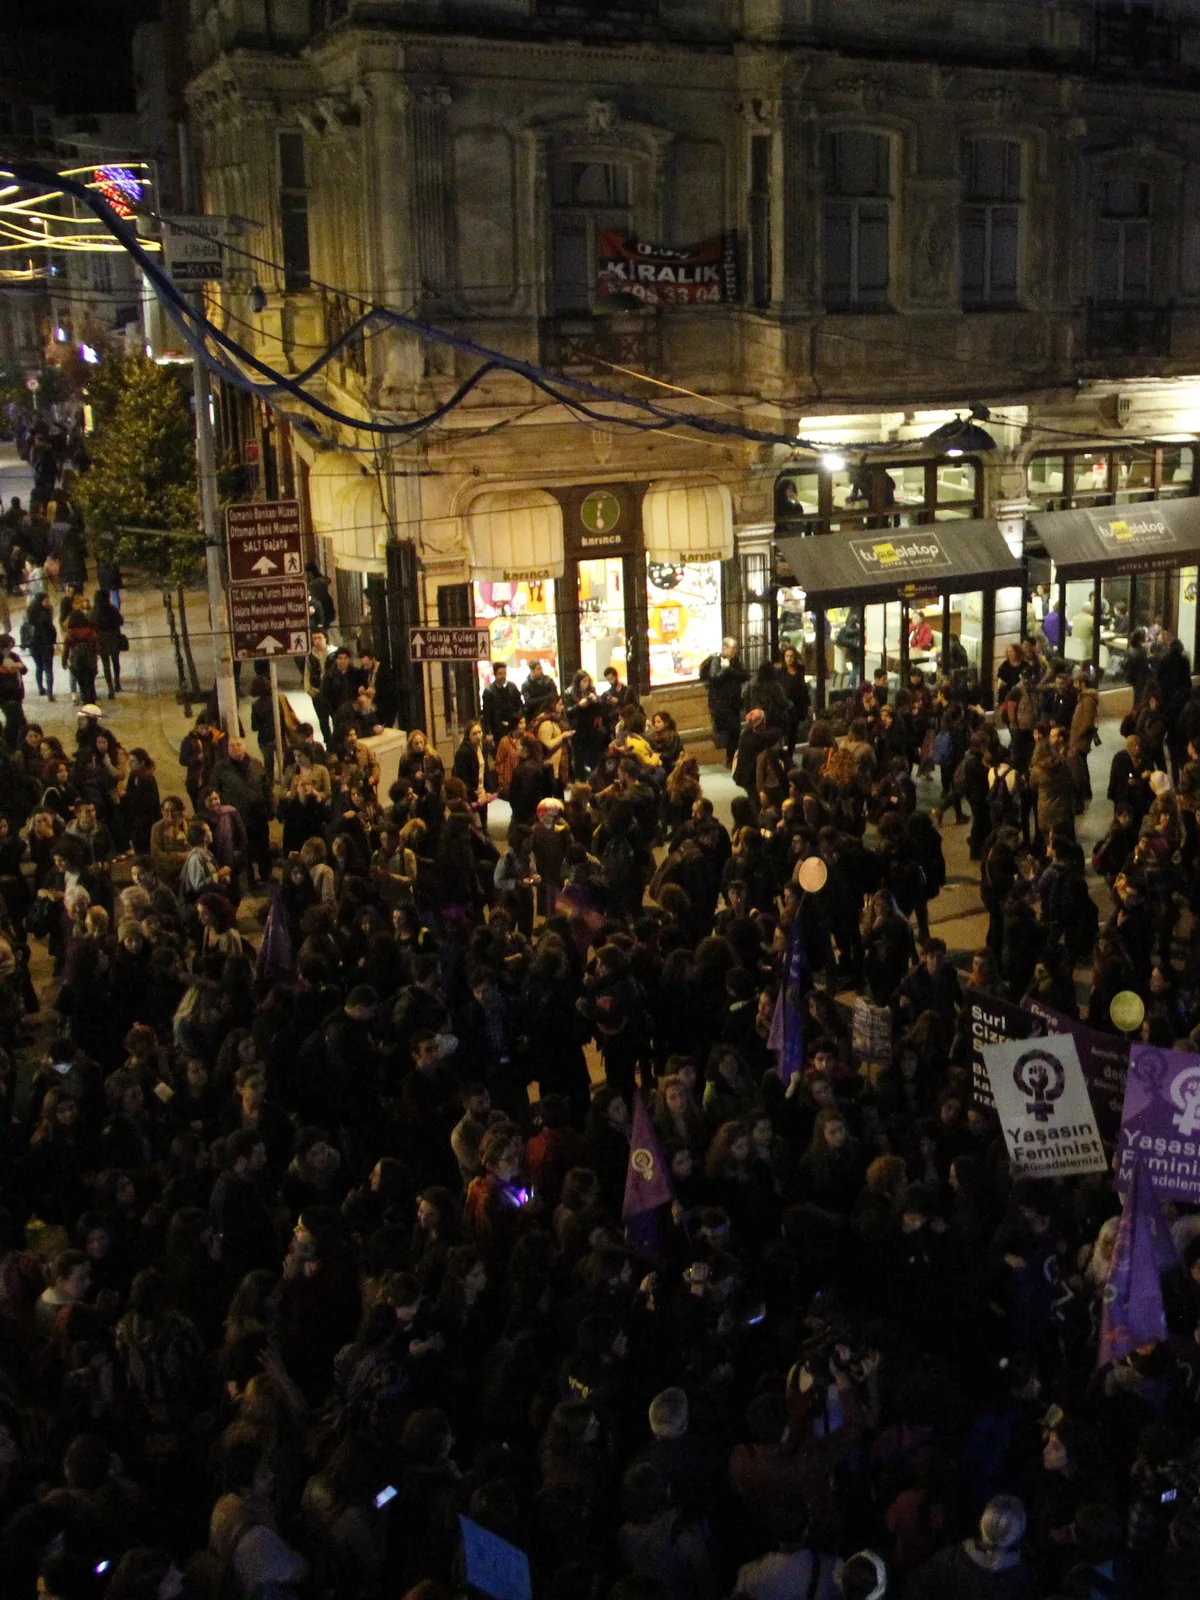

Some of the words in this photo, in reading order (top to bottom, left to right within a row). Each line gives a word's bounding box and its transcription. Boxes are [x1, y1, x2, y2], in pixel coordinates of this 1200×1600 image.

[263, 539, 288, 552] Galata
[426, 631, 450, 643] Galata
[452, 630, 476, 643] Kulesi
[1007, 1123, 1093, 1145] Yaşasın
[1014, 1140, 1100, 1161] Feminist
